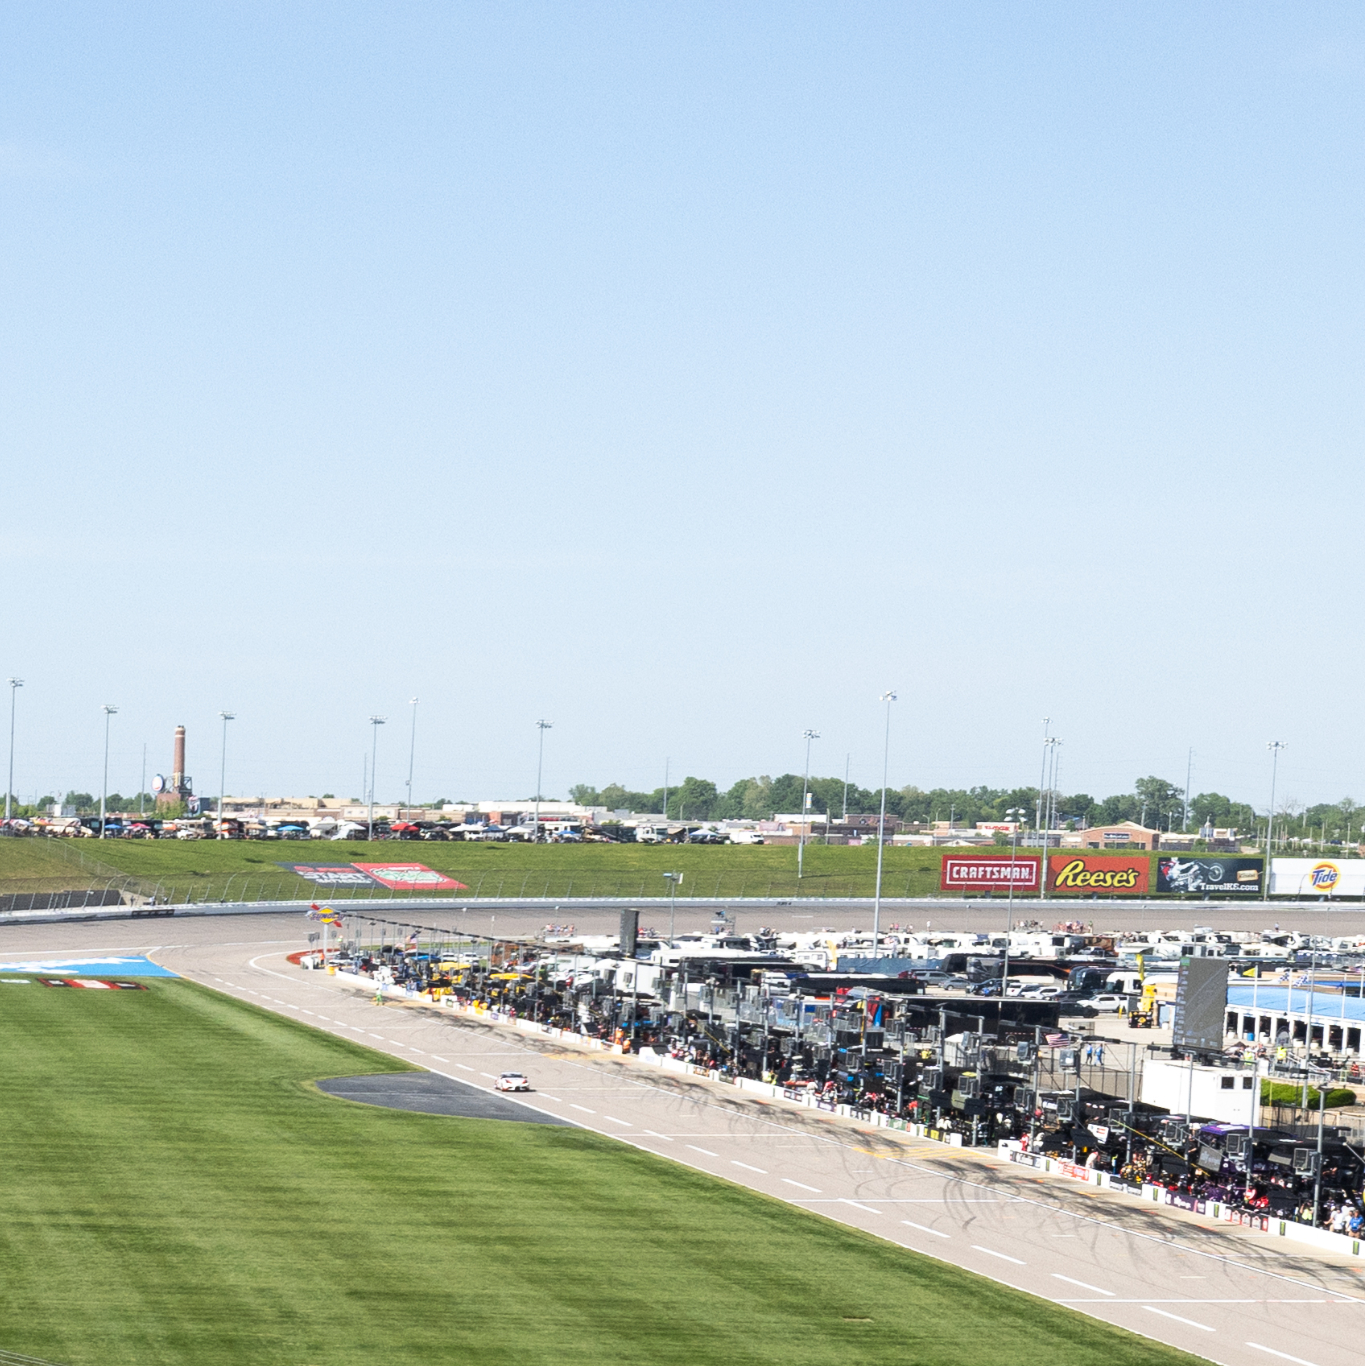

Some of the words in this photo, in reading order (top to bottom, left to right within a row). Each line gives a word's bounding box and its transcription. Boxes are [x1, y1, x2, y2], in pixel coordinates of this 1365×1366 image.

[952, 866, 1031, 880] CRAFTSMAN
[1056, 860, 1140, 887] Reese's
[1312, 869, 1338, 886] Tide
[1199, 882, 1259, 891] TravelKS.com
